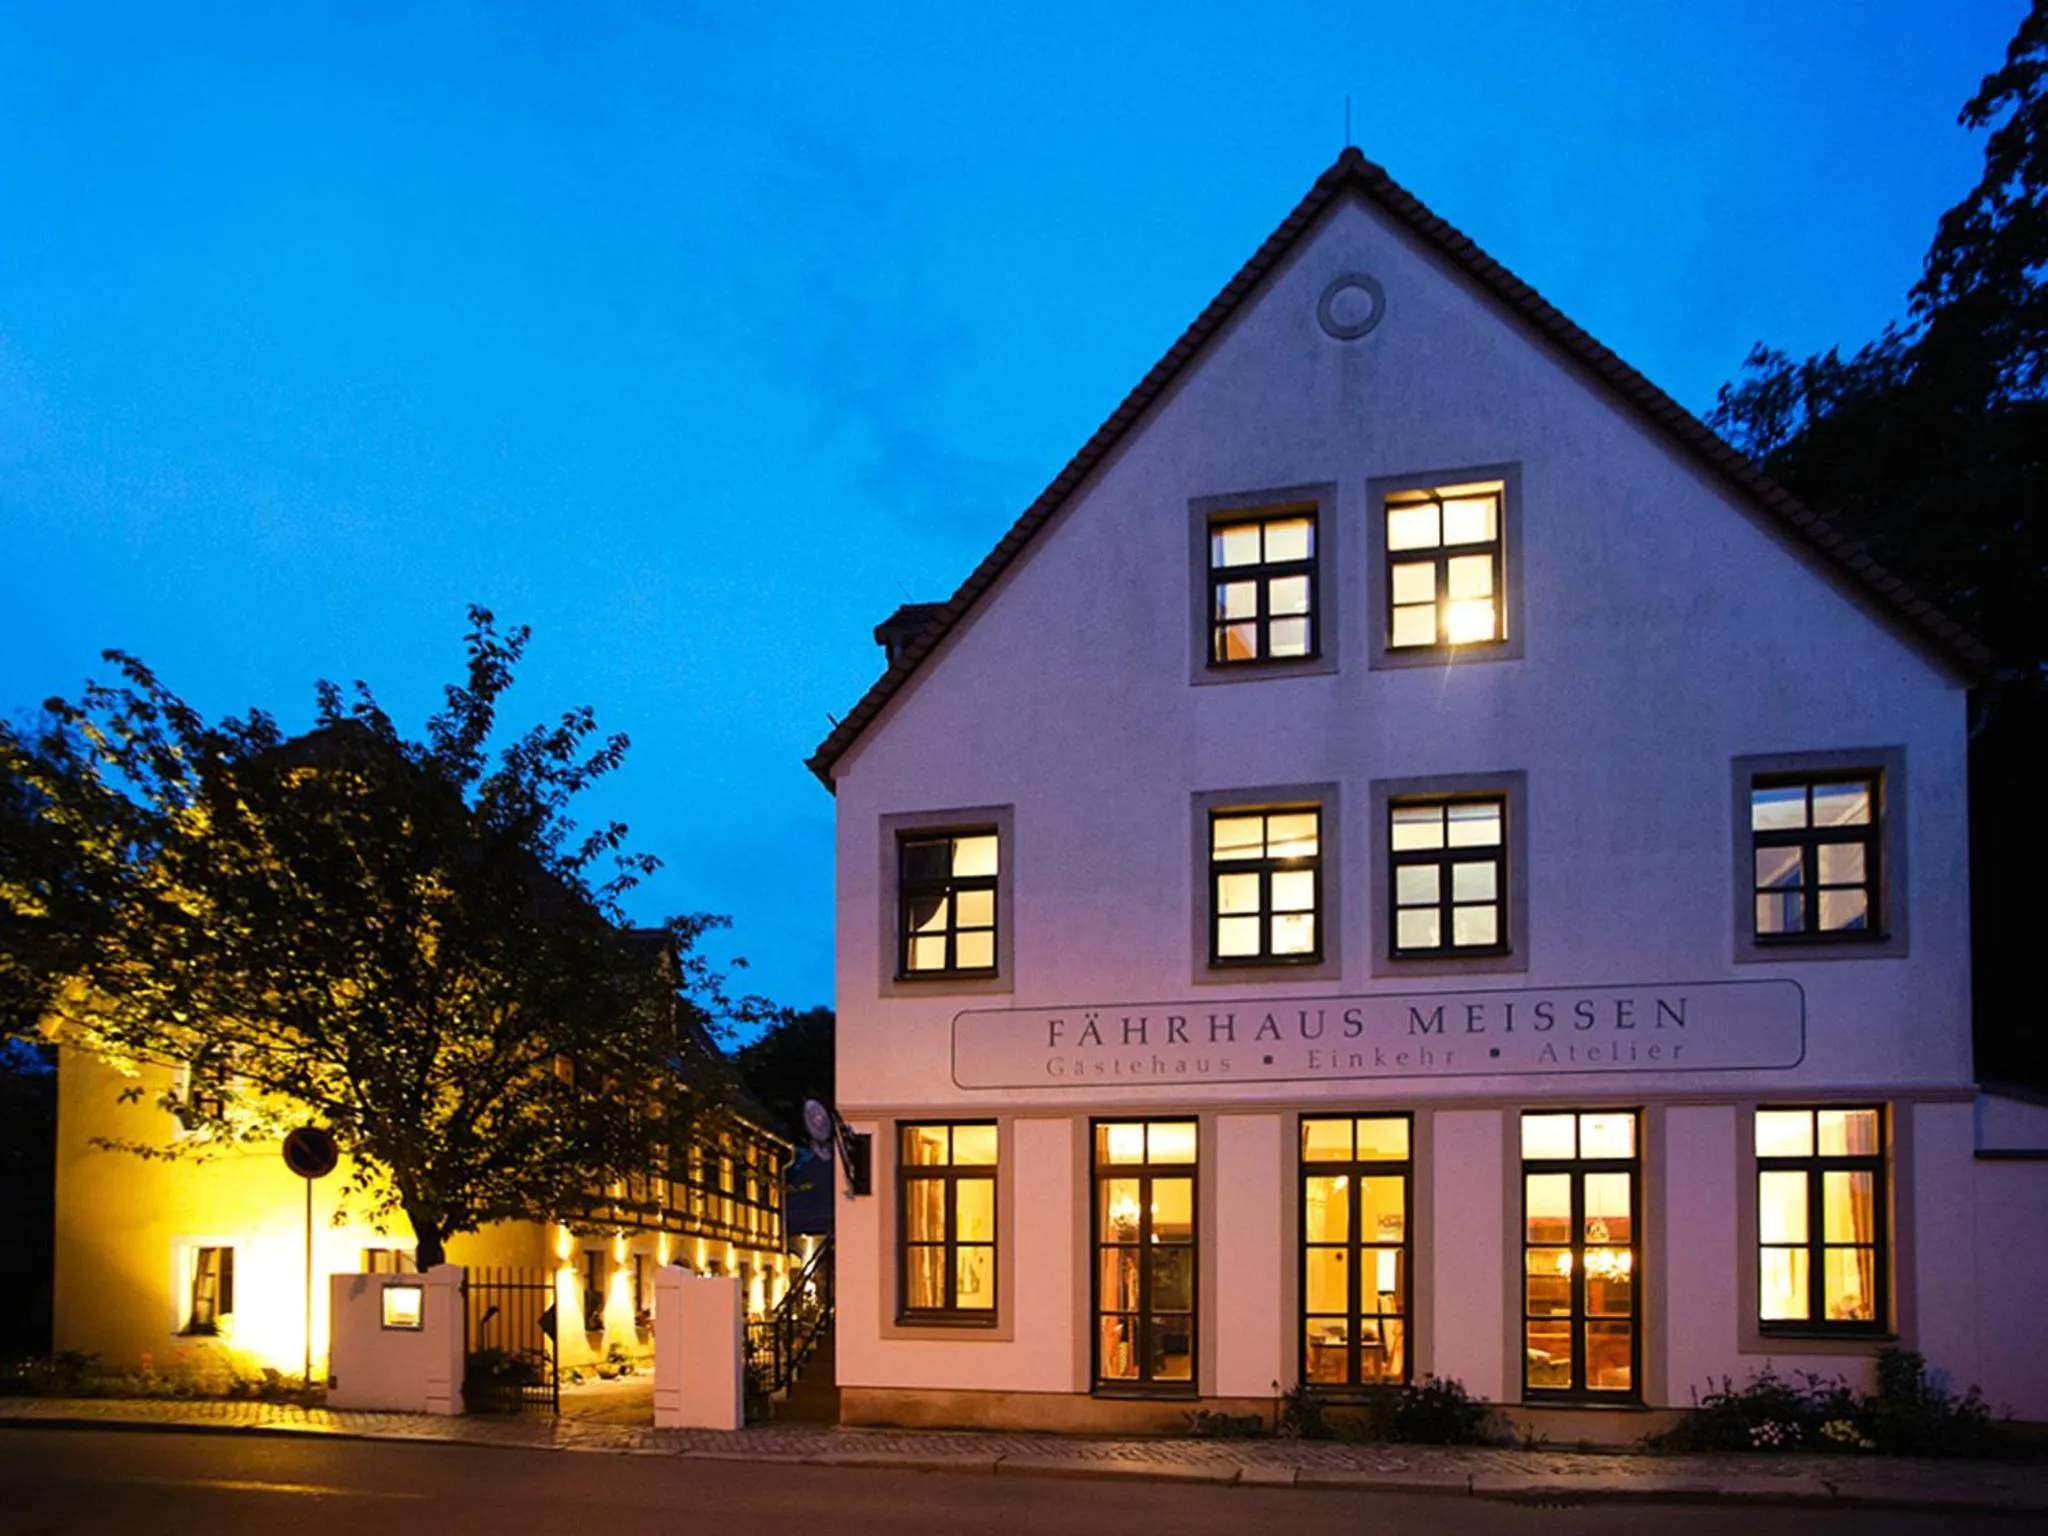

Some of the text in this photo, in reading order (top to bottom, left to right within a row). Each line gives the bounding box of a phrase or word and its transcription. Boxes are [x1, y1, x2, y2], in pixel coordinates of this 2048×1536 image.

[1048, 998, 1687, 1047] FÄHRHAUS MEISSEN
[1308, 1047, 1455, 1069] Einkehr
[1538, 1040, 1683, 1063] Atelier
